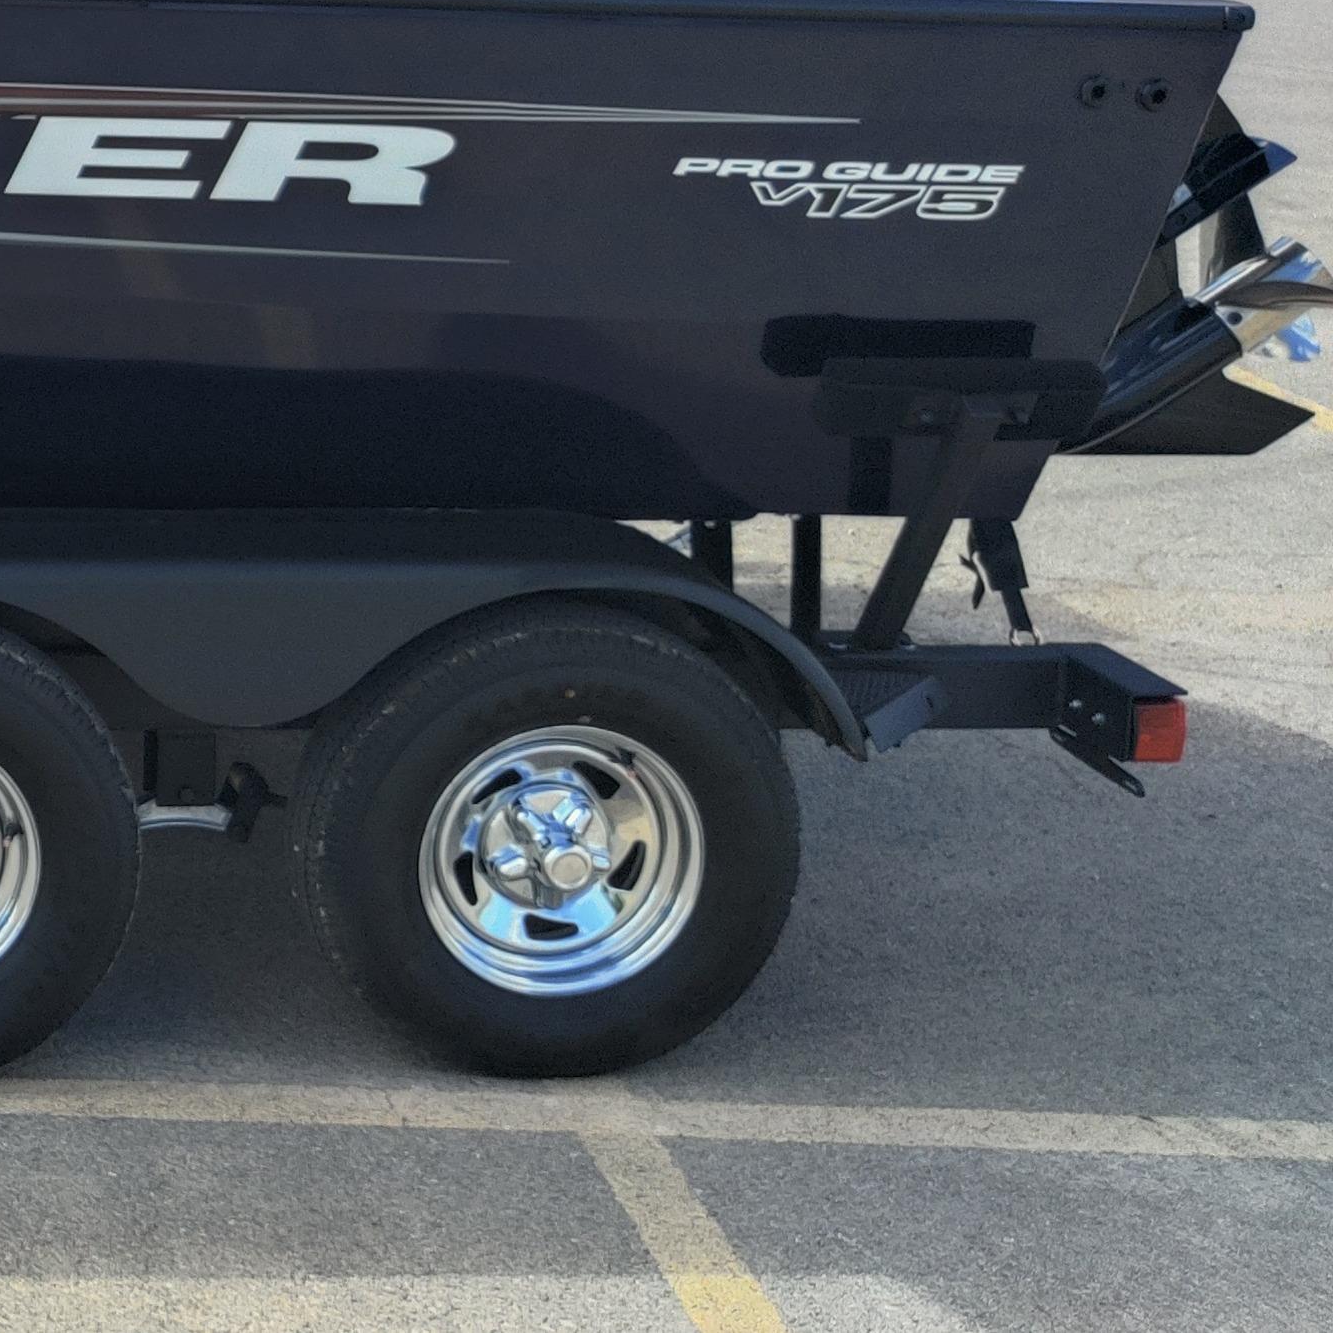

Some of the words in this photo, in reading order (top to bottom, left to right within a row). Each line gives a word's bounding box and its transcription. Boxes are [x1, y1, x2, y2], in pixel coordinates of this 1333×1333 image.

[672, 157, 815, 179] PRO
[822, 162, 1025, 184] GUIDE
[749, 181, 1006, 221] V175
